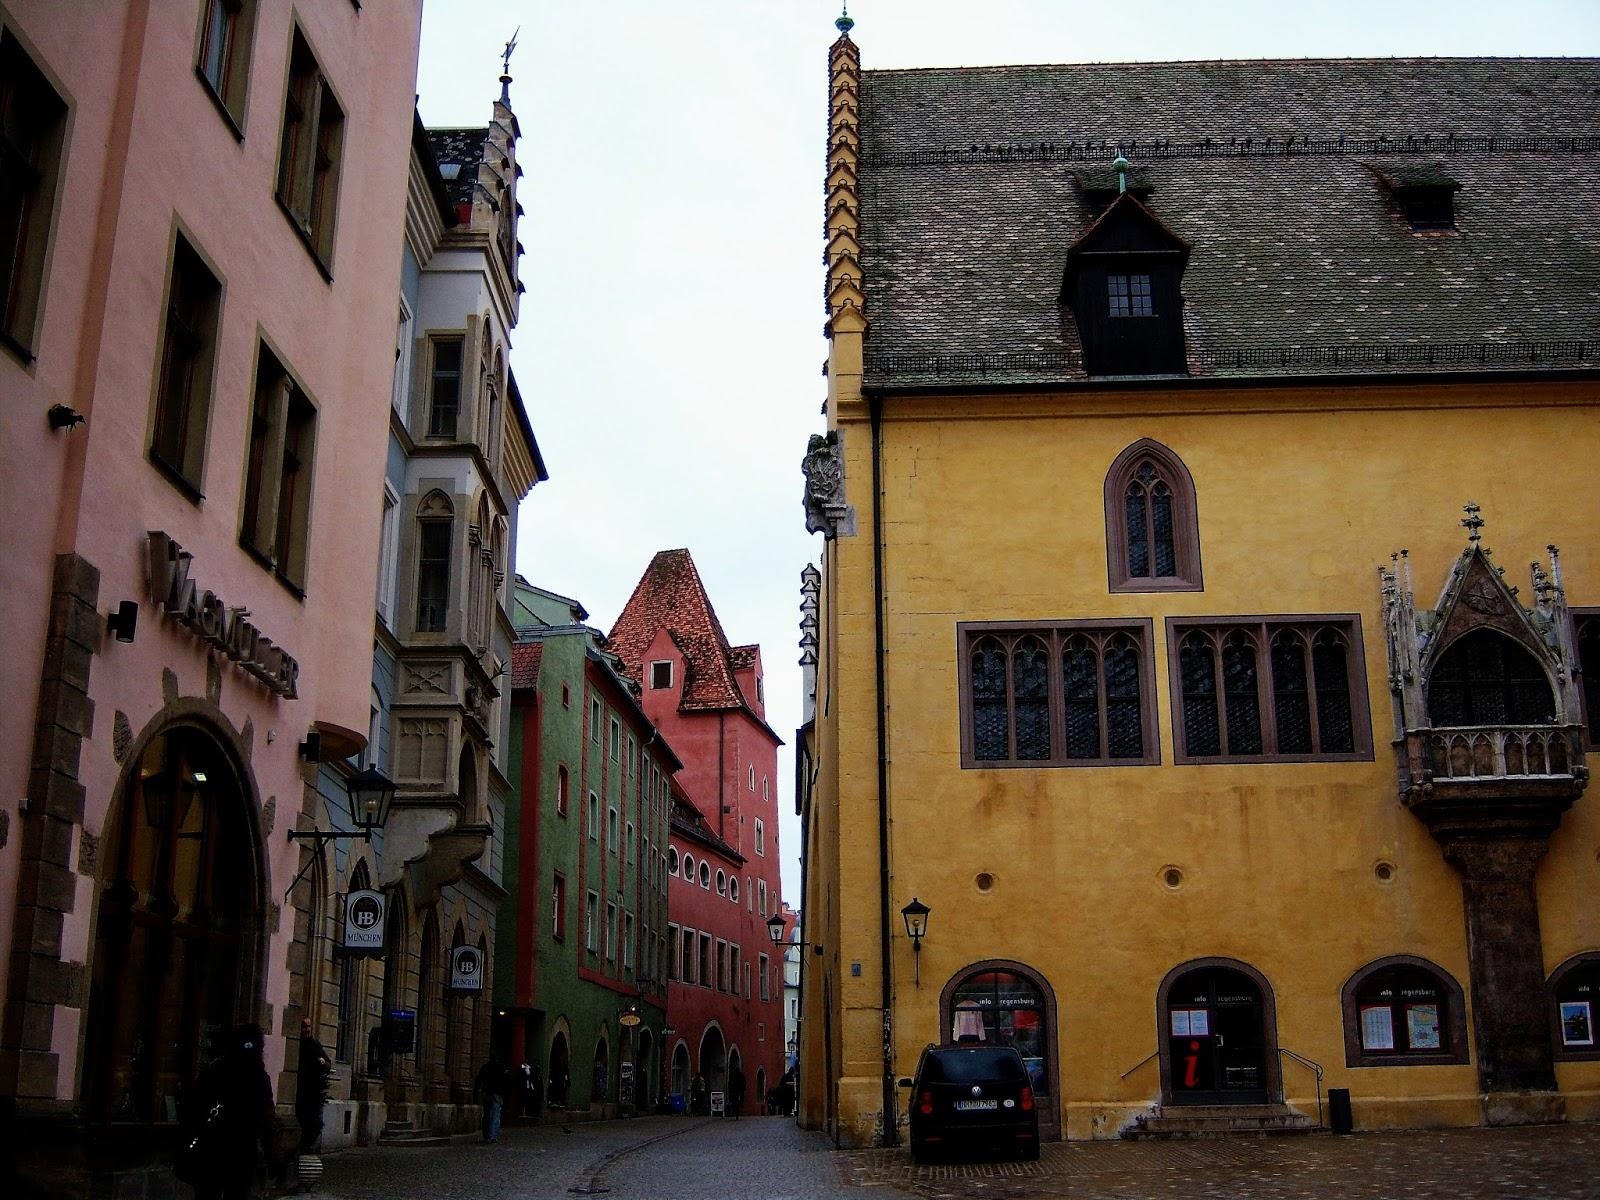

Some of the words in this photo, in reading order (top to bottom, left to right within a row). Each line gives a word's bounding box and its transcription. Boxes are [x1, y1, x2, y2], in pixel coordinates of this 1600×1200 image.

[357, 911, 375, 926] HB
[347, 932, 382, 943] MÜNCHEN
[461, 961, 474, 973] HB
